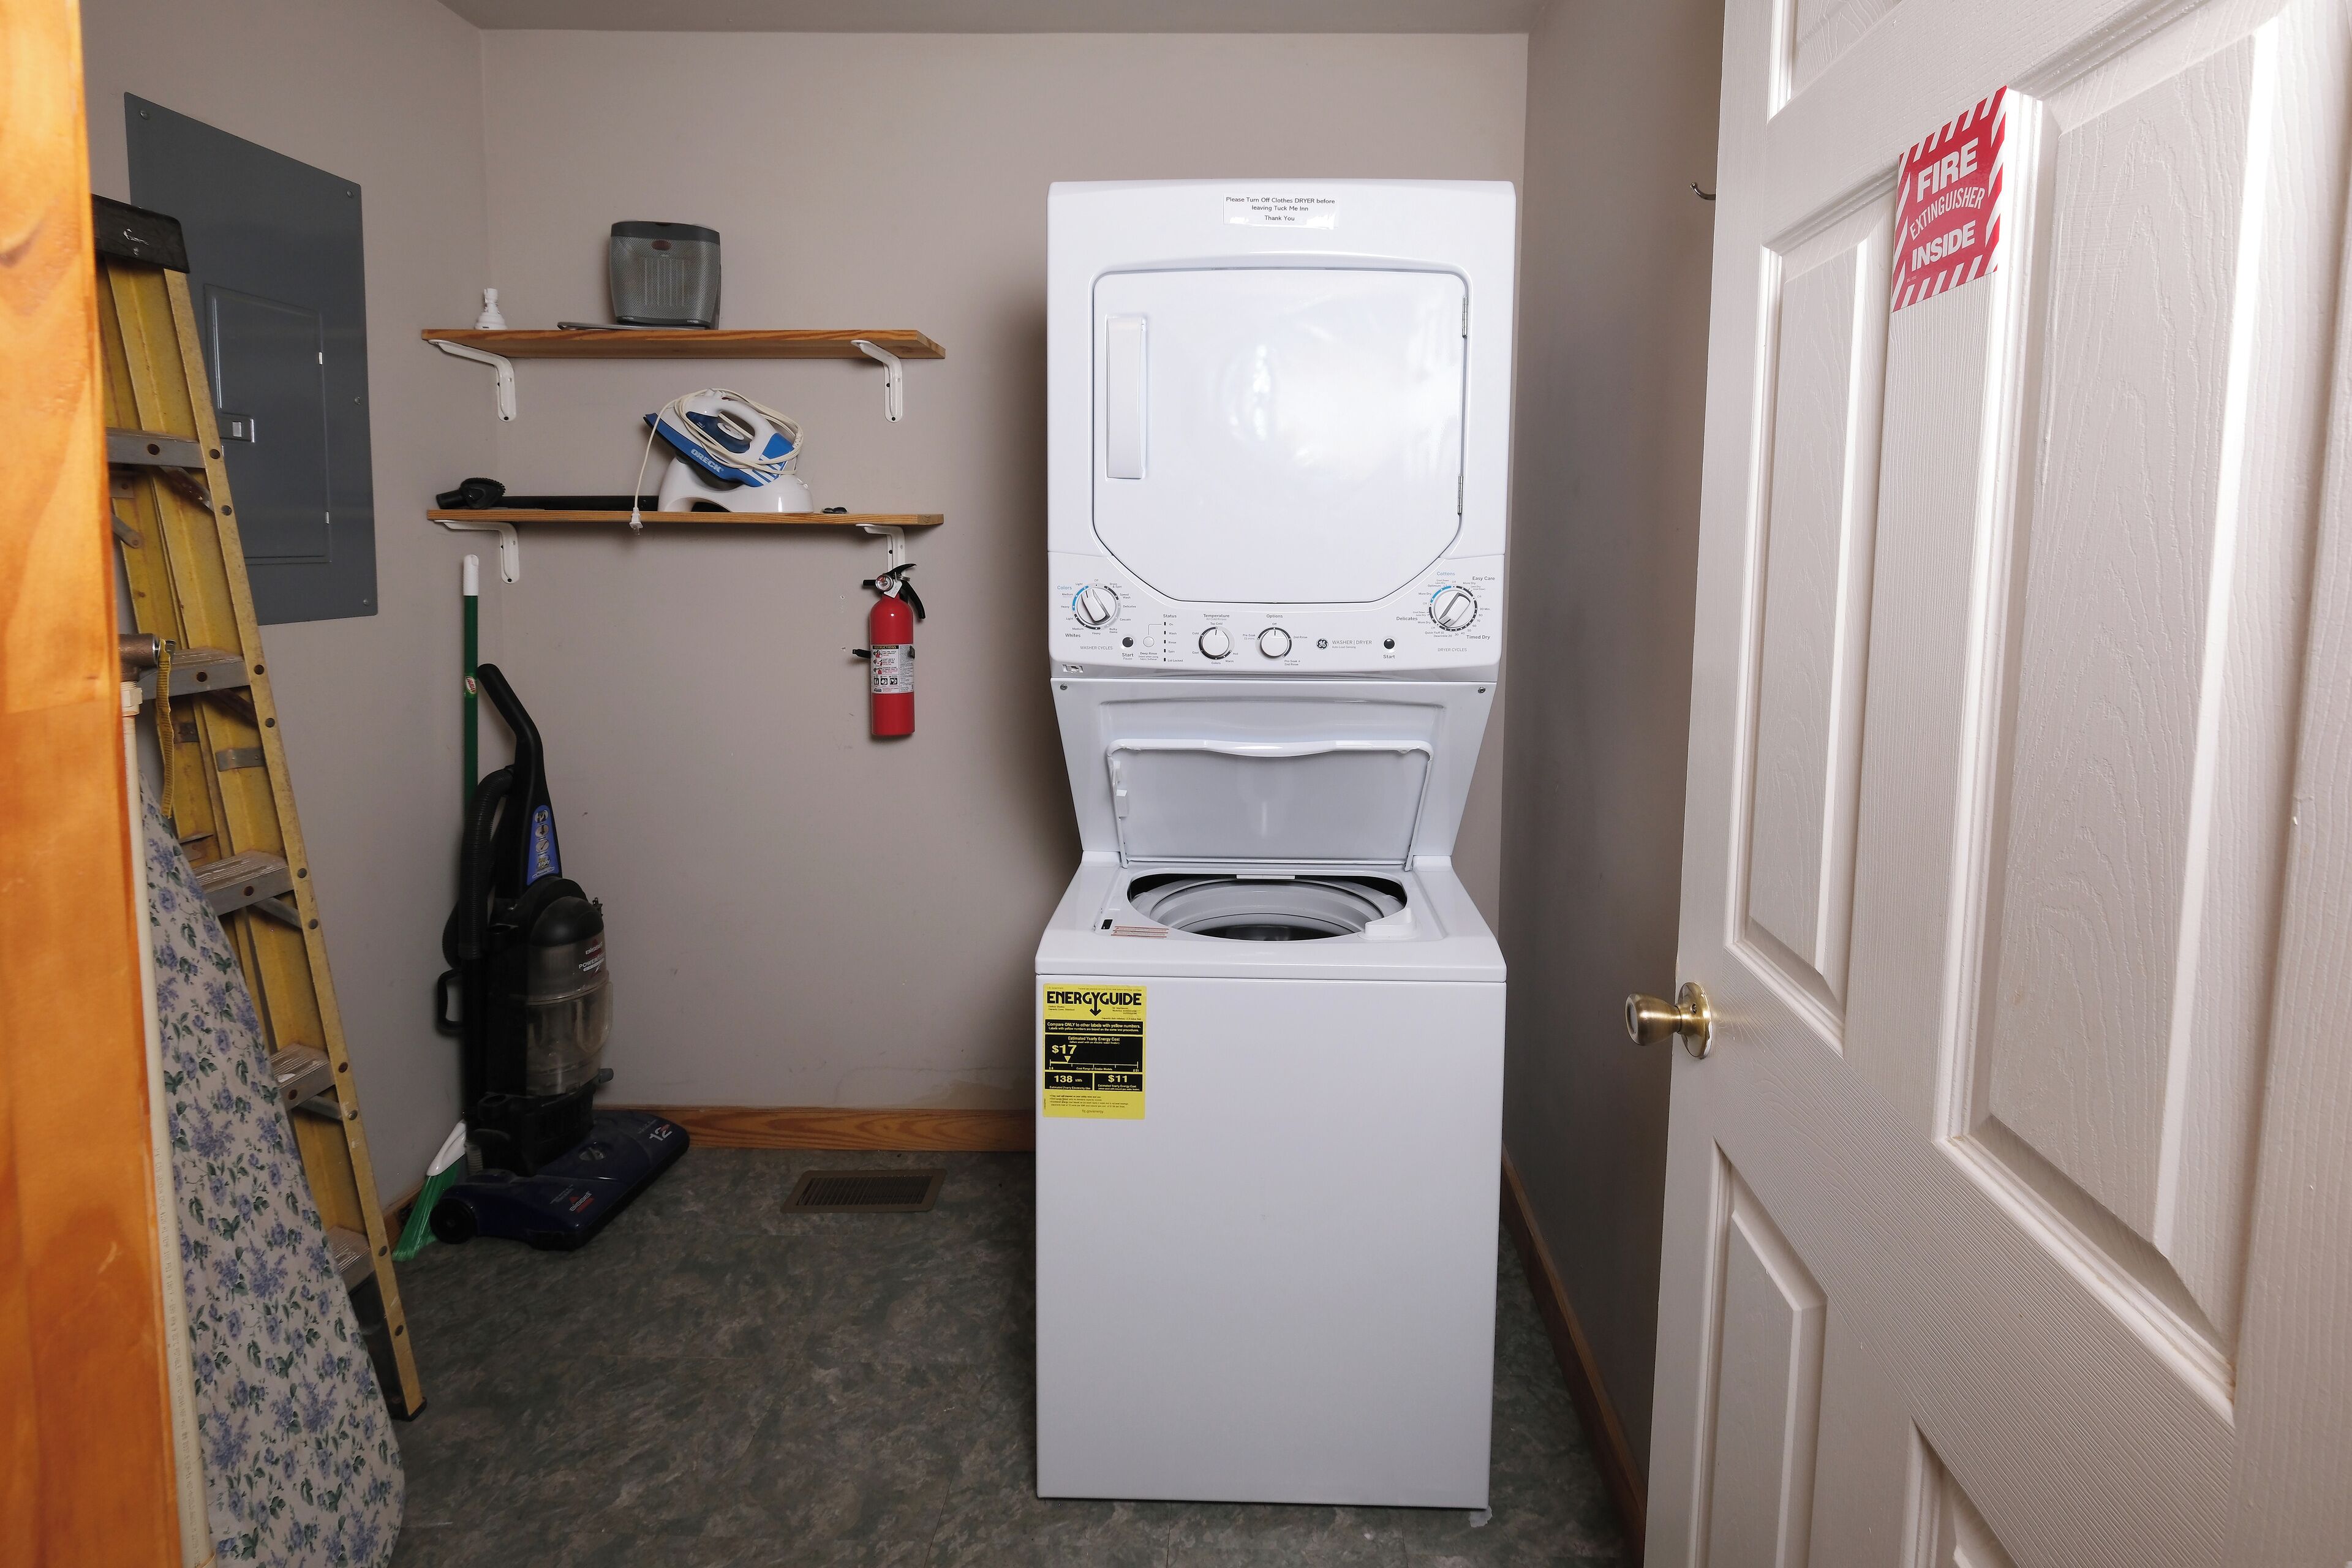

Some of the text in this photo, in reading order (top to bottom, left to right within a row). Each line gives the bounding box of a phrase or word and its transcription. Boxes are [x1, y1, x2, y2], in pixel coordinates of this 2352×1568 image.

[1917, 137, 1978, 203] FIRE
[1910, 187, 1985, 240] EXTINGUISHER
[1911, 220, 1976, 272] INSIDE
[691, 449, 722, 473] ORECK
[1047, 991, 1142, 1005] ENERGYGUIDE
[1052, 1044, 1077, 1054] $17
[1108, 1075, 1127, 1083] $11
[649, 1125, 672, 1141] 12
